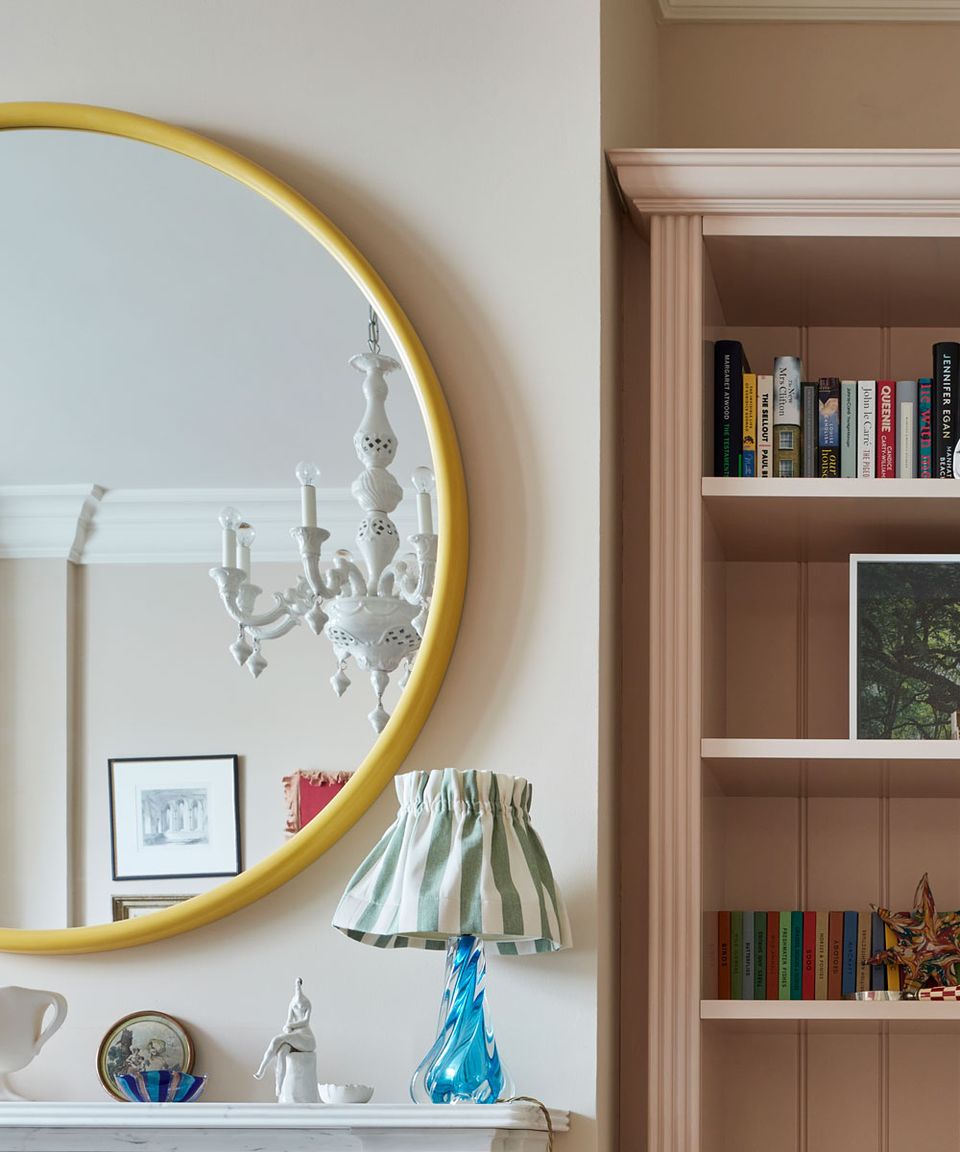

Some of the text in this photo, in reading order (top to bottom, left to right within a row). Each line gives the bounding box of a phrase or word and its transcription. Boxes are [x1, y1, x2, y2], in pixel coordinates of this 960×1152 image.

[779, 367, 787, 416] Mrs Clifton
[881, 385, 891, 432] QUEENIE
[921, 384, 931, 403] lie
[943, 353, 951, 439] JENNIFER EGAN
[862, 387, 872, 446] John le Carré
[921, 408, 931, 448] with
